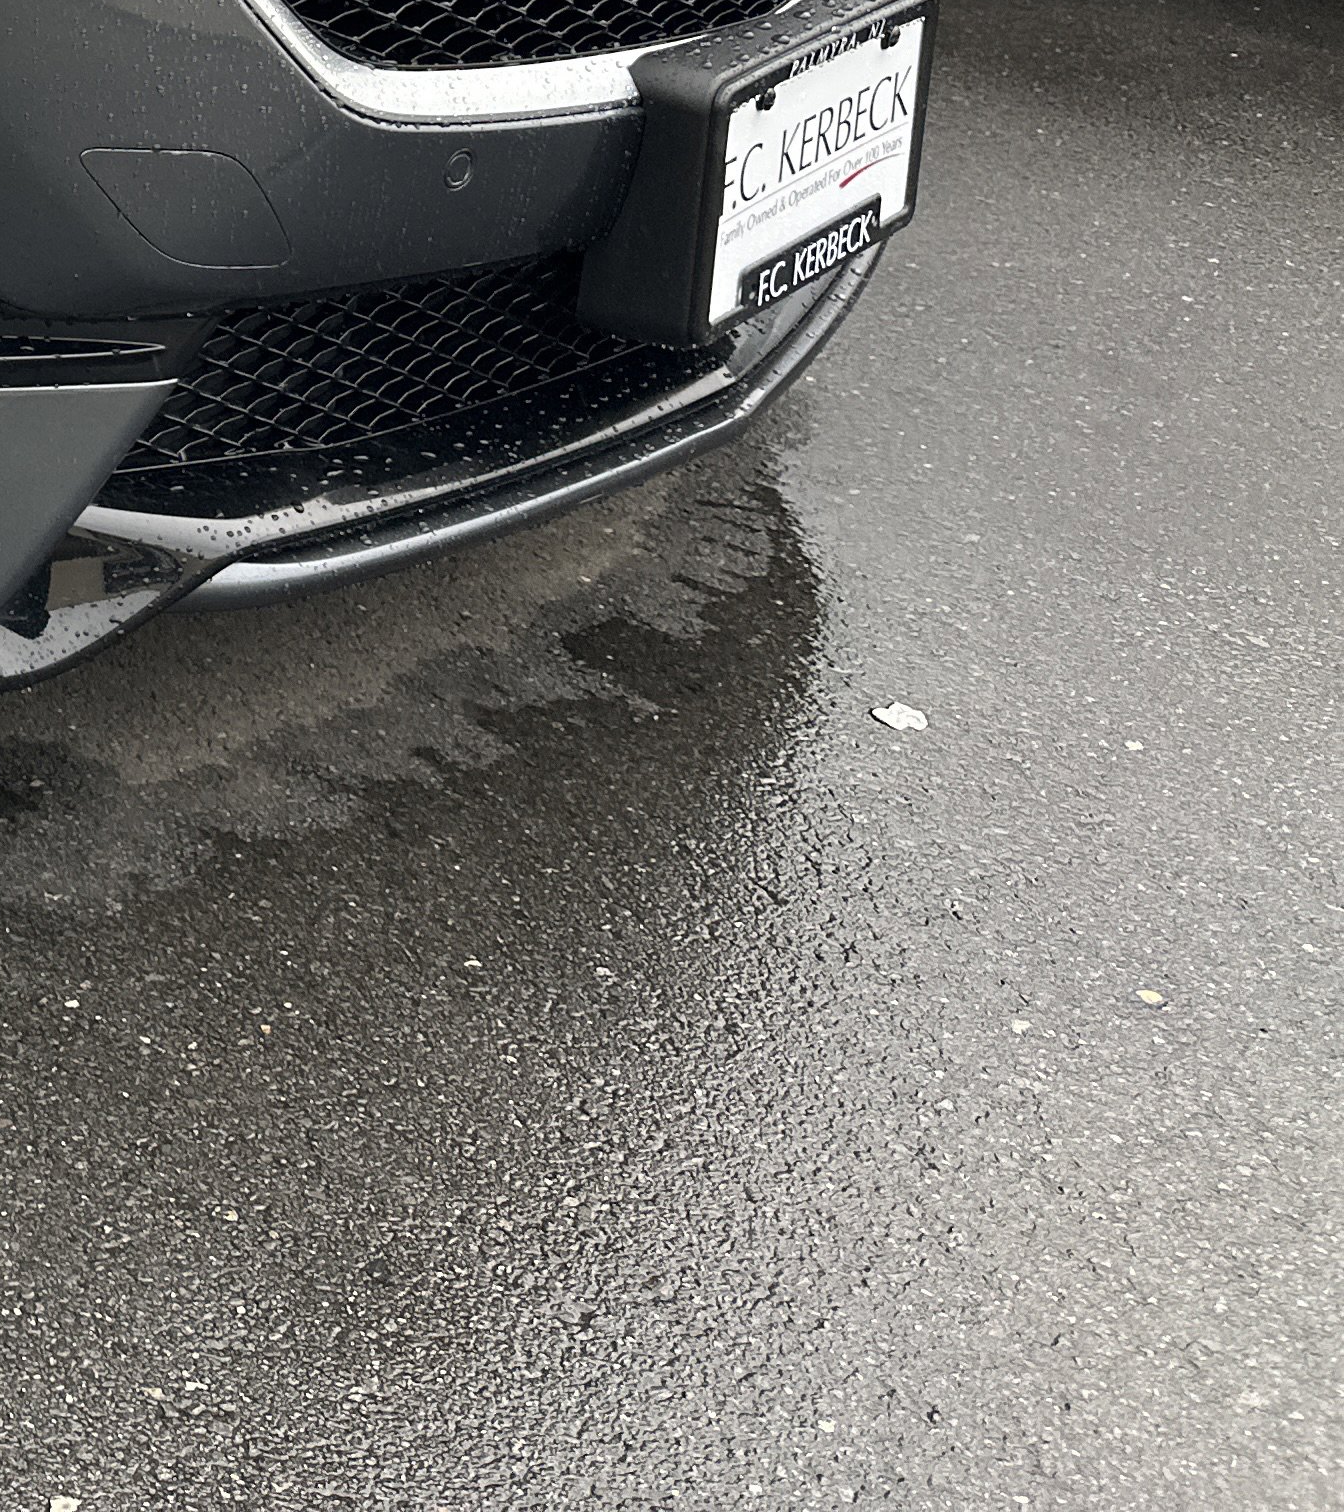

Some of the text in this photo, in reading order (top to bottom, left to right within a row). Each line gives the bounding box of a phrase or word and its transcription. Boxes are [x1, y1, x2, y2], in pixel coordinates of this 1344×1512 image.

[778, 65, 912, 183] KERBECK
[720, 137, 903, 247] Family Owned & Operated For Over 100 Years
[758, 210, 874, 306] F.C. KERBECK
